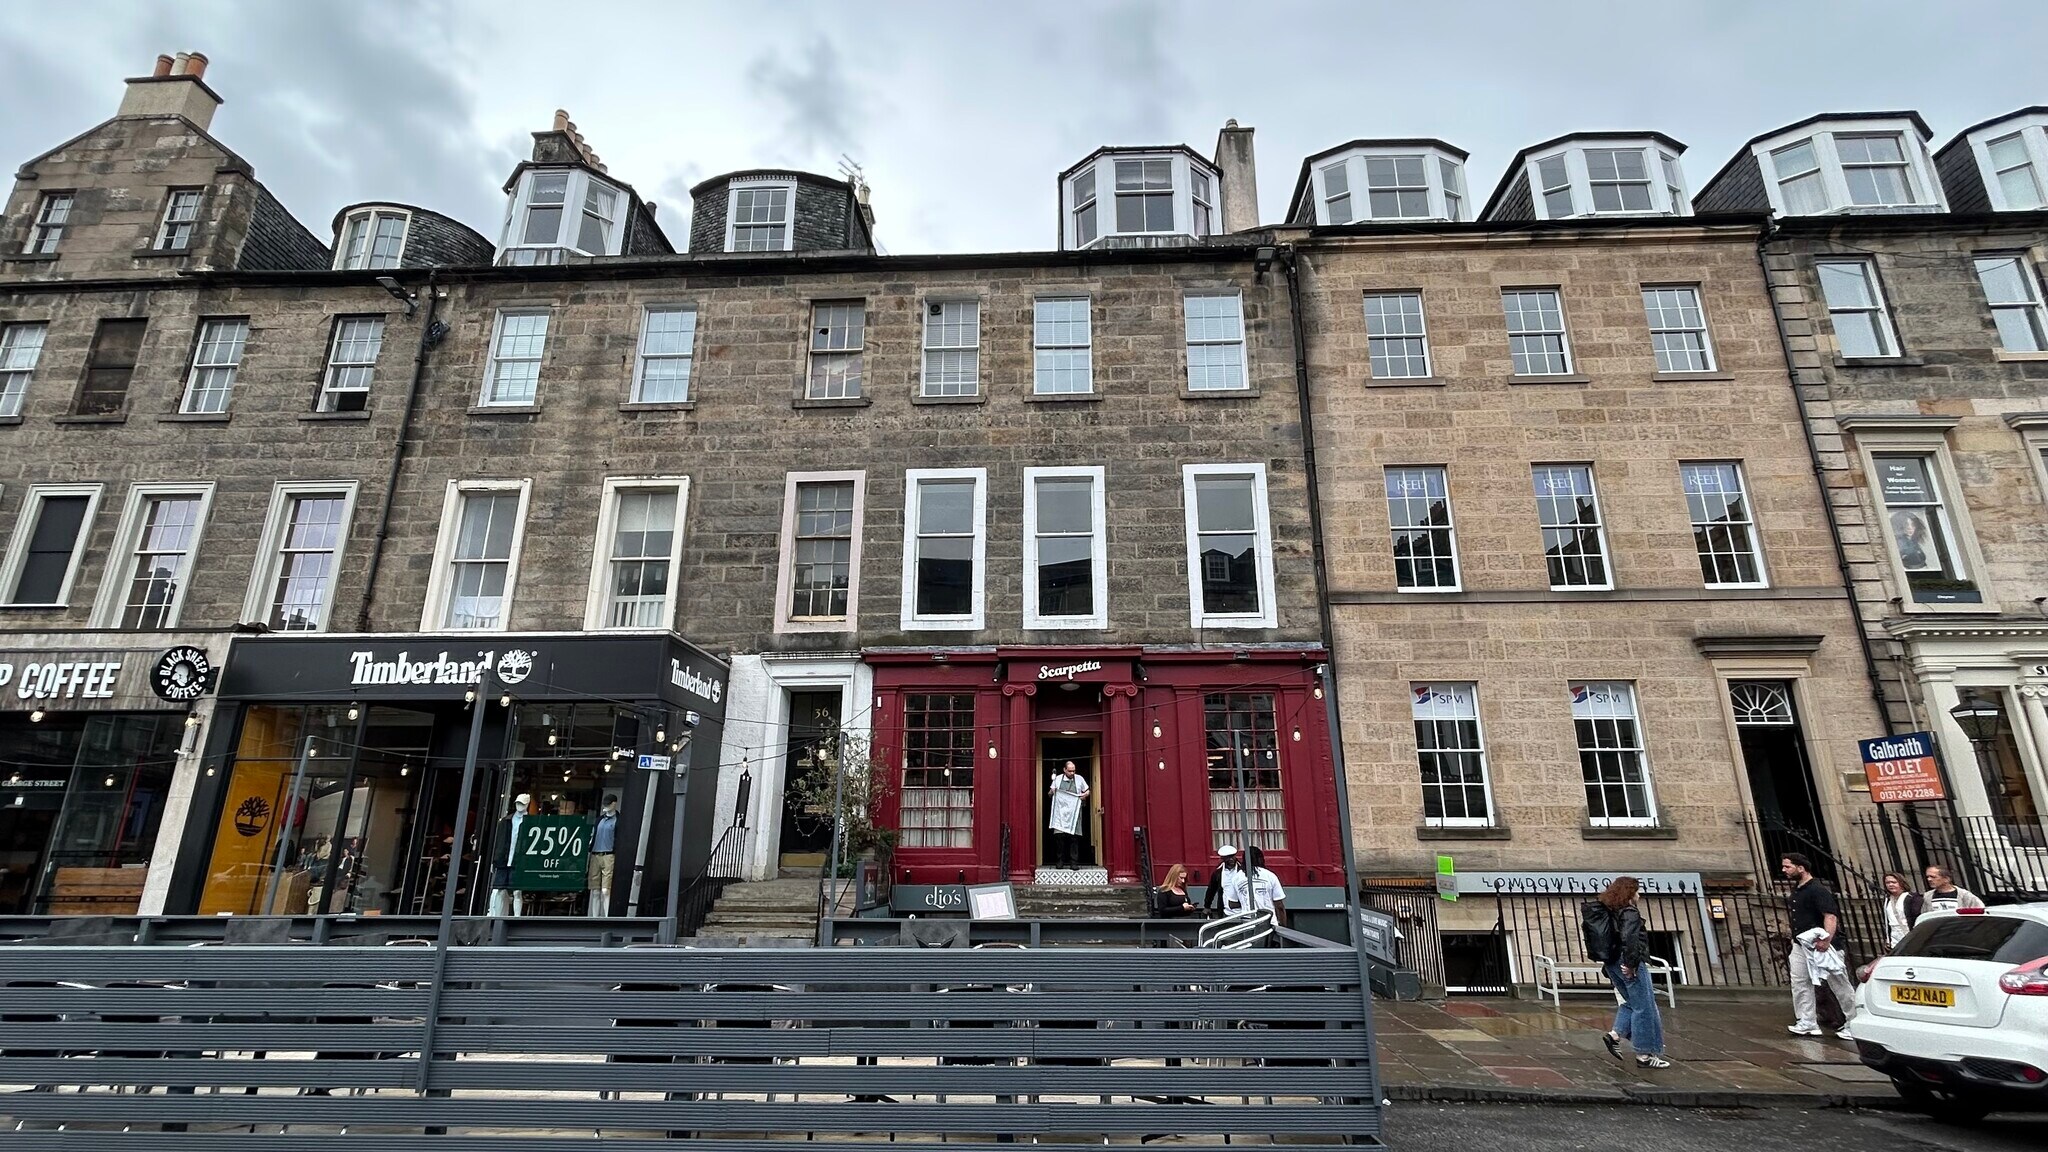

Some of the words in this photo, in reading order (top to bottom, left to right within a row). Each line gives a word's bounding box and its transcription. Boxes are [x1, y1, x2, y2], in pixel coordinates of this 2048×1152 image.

[1687, 474, 1720, 486] REED
[159, 649, 185, 676] BLACK
[185, 649, 208, 673] SHEEP
[350, 651, 494, 684] Timberland
[1038, 660, 1102, 680] Scarpetta
[2035, 665, 2048, 676] S
[17, 662, 121, 699] COFFEE
[671, 657, 713, 700] Timberland
[165, 681, 203, 699] COFFEE
[1595, 693, 1621, 703] SPM
[1439, 694, 1464, 704] SPM
[814, 706, 829, 720] 36
[1869, 737, 1923, 760] Galbraith
[1875, 761, 1895, 776] TO
[1897, 759, 1922, 774] LET
[1880, 791, 1896, 800] 0131
[1897, 790, 1913, 799] 240
[1914, 788, 1935, 798] 2288
[525, 826, 582, 857] 25%
[543, 858, 560, 868] OFF
[1589, 877, 1655, 888] COEE
[1896, 987, 1921, 1001] M321
[1923, 989, 1947, 1004] NAD
